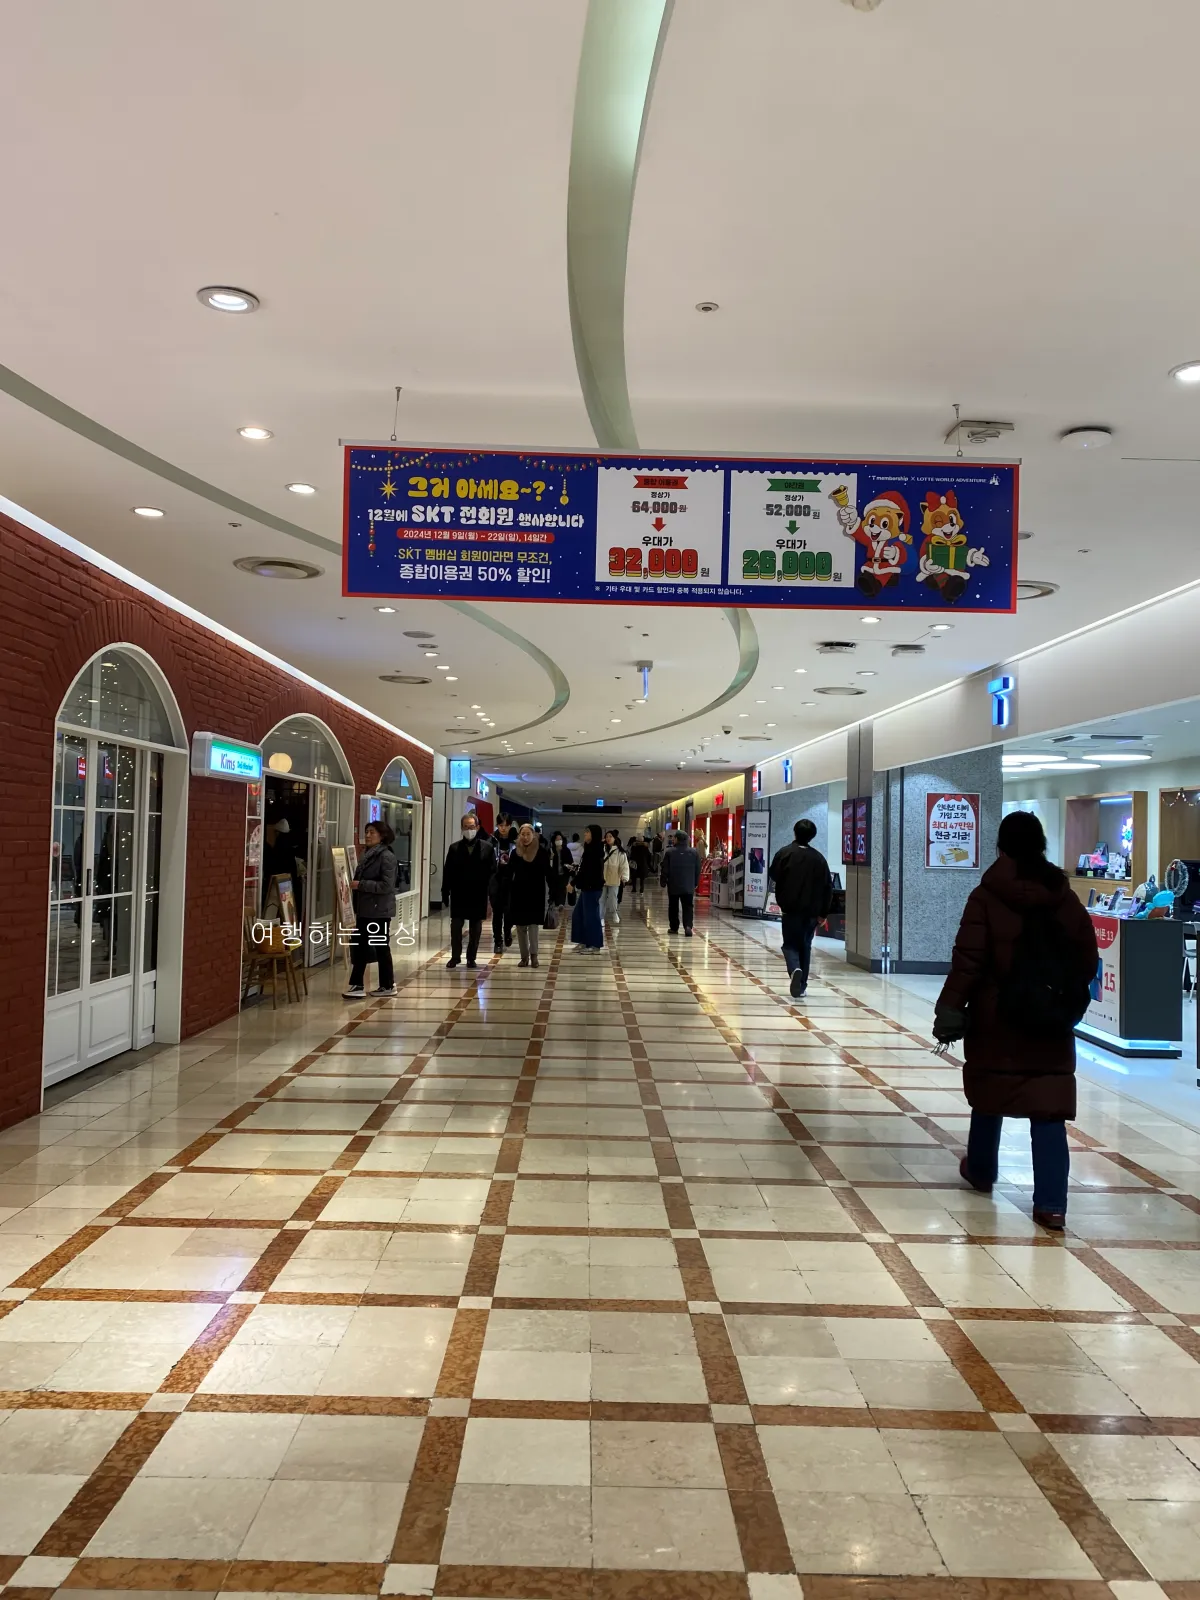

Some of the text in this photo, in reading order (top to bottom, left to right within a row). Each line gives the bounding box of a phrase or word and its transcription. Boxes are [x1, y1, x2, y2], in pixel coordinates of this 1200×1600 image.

[408, 476, 546, 502] 그거 아세요~?
[368, 504, 585, 528] 12월에 SKT 전회원 행사합니다
[403, 530, 432, 538] 2024년
[434, 530, 450, 540] 12월
[452, 531, 478, 540] 9일(월)
[524, 533, 548, 542] 14일간
[642, 536, 674, 547] 우대가
[776, 538, 807, 550] 우대가
[398, 548, 552, 566] SKT 멤버십 회원이라면 무조건,
[400, 563, 551, 584] 종합이용권 50% 할인!
[932, 820, 948, 830] 최대
[935, 830, 951, 840] 현금
[1107, 930, 1114, 942] 13
